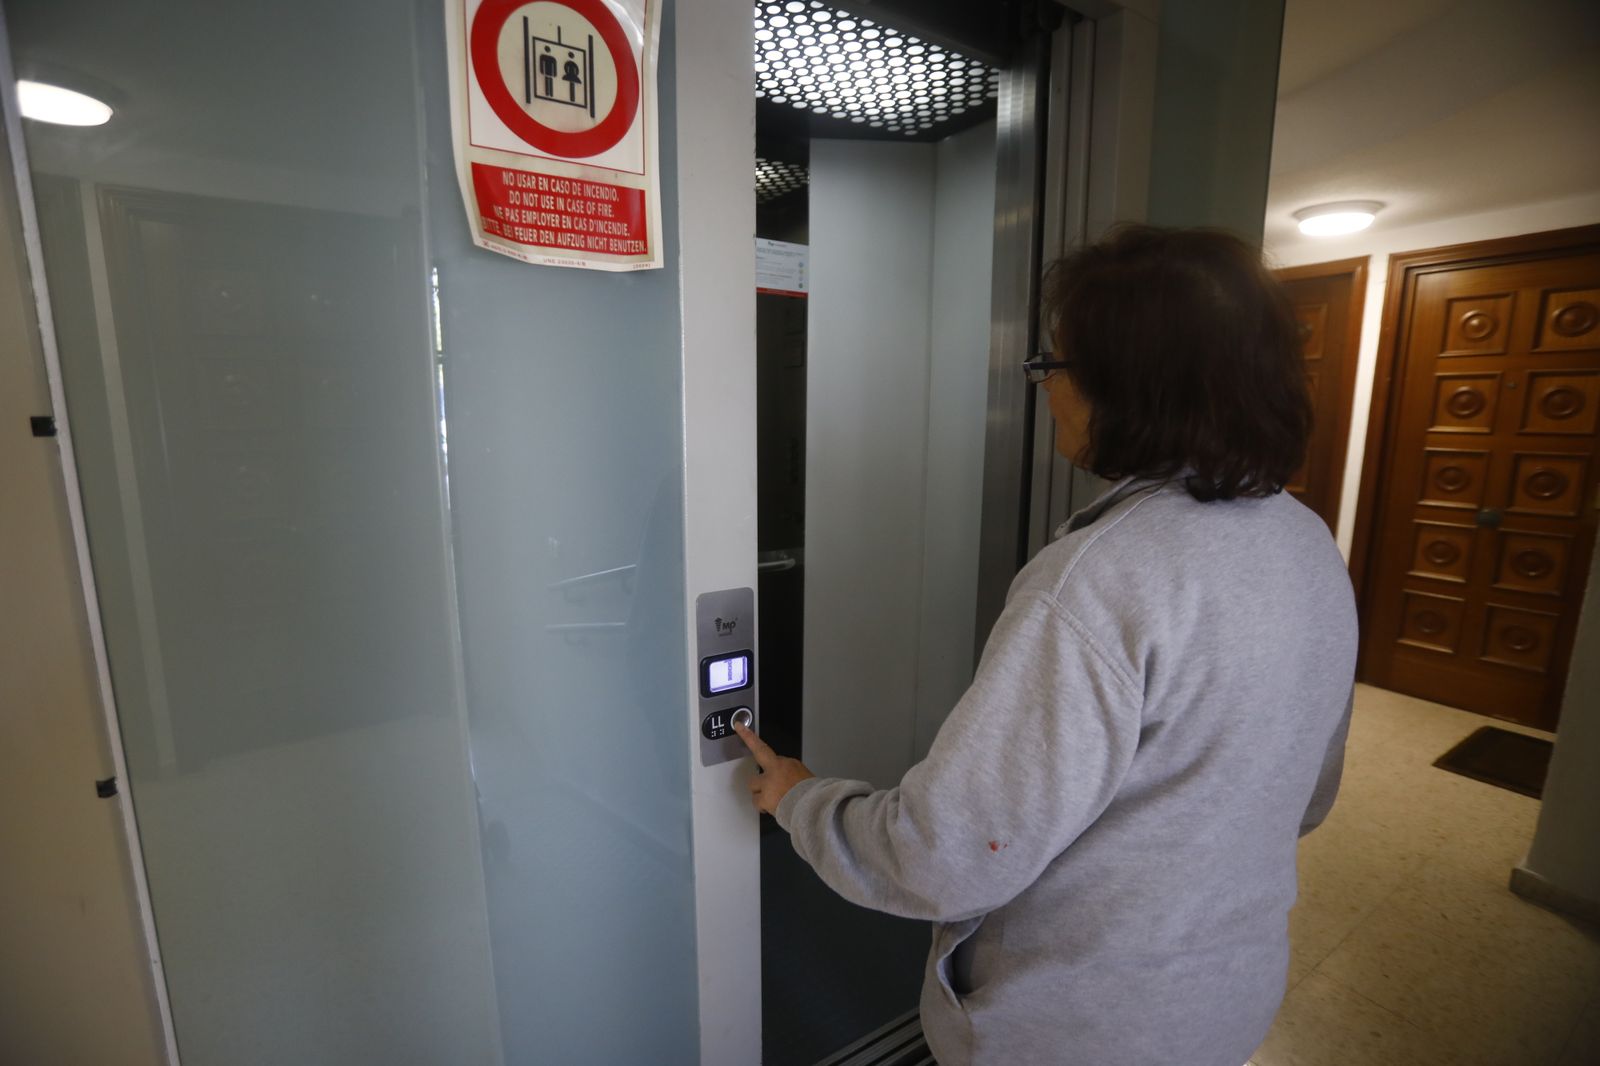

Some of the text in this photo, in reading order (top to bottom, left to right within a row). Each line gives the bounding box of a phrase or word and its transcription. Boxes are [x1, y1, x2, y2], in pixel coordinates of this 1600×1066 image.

[502, 171, 514, 186] NO
[517, 174, 536, 189] USAR
[538, 177, 548, 191] EN
[551, 179, 570, 194] CASO
[572, 182, 582, 196] DE
[509, 190, 520, 204] DO
[523, 192, 538, 207] NOT
[541, 196, 554, 210] USE
[557, 198, 564, 211] IN
[567, 199, 584, 214] CASE
[586, 202, 596, 215] OF
[505, 208, 519, 222] PAS
[522, 210, 560, 228] EMPLOYER
[562, 216, 572, 229] EN
[574, 218, 587, 231] CAS
[514, 227, 537, 242] FEUER
[540, 230, 554, 244] DEN
[557, 232, 584, 248] AUFZUG
[587, 236, 607, 250] NICHT
[712, 716, 724, 728] LL
